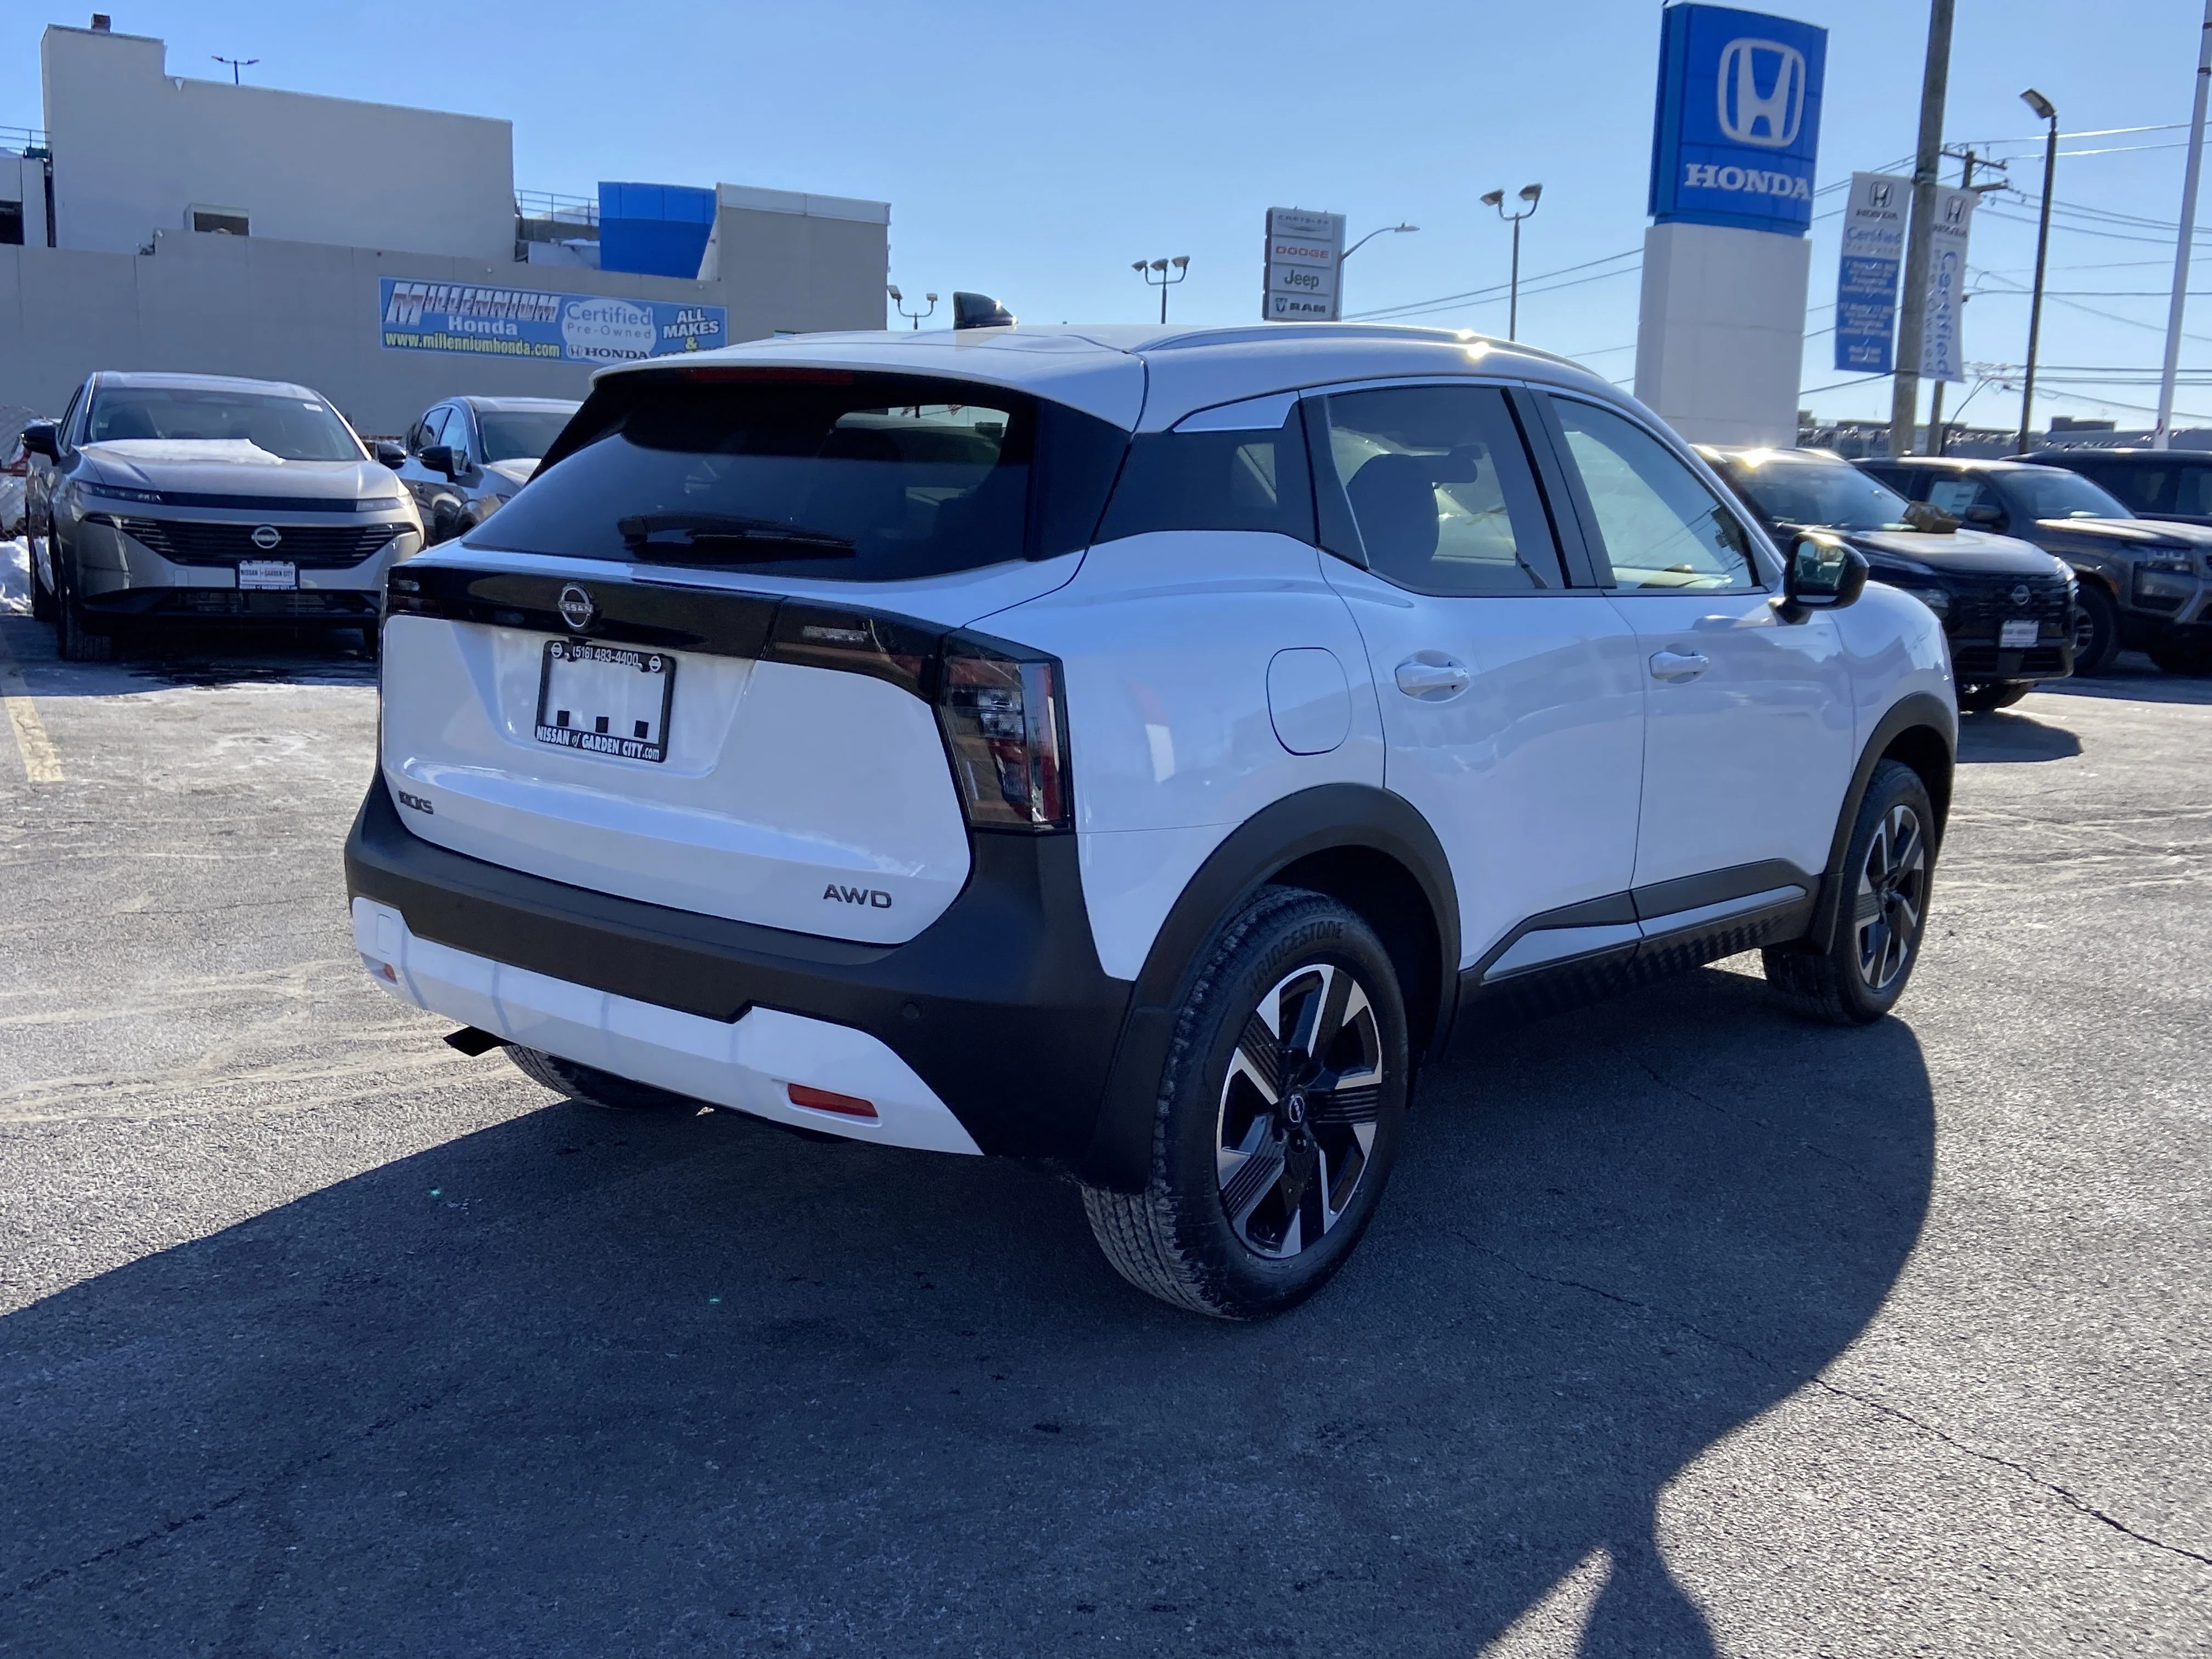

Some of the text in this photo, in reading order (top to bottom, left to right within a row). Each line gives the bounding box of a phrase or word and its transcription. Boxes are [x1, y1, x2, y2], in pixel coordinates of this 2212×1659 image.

[1685, 163, 1810, 200] HONDA
[1276, 246, 1329, 258] DODGE
[1284, 269, 1319, 289] Jeep
[386, 282, 562, 326] MILLENNIUM
[1290, 303, 1325, 312] RAM
[567, 303, 651, 325] Certified
[677, 309, 706, 323] ALL
[448, 315, 517, 335] Honda
[568, 323, 651, 338] Pre-Owned
[663, 321, 719, 338] MAKES
[386, 332, 560, 357] www.millenniumhonda.com
[685, 337, 697, 349] &
[584, 347, 648, 359] HONDA
[573, 646, 639, 665] (516) 483-4400
[537, 725, 570, 745] NISSAN
[572, 732, 581, 747] of
[582, 734, 619, 754] GARDEN
[823, 884, 891, 909] AWD
